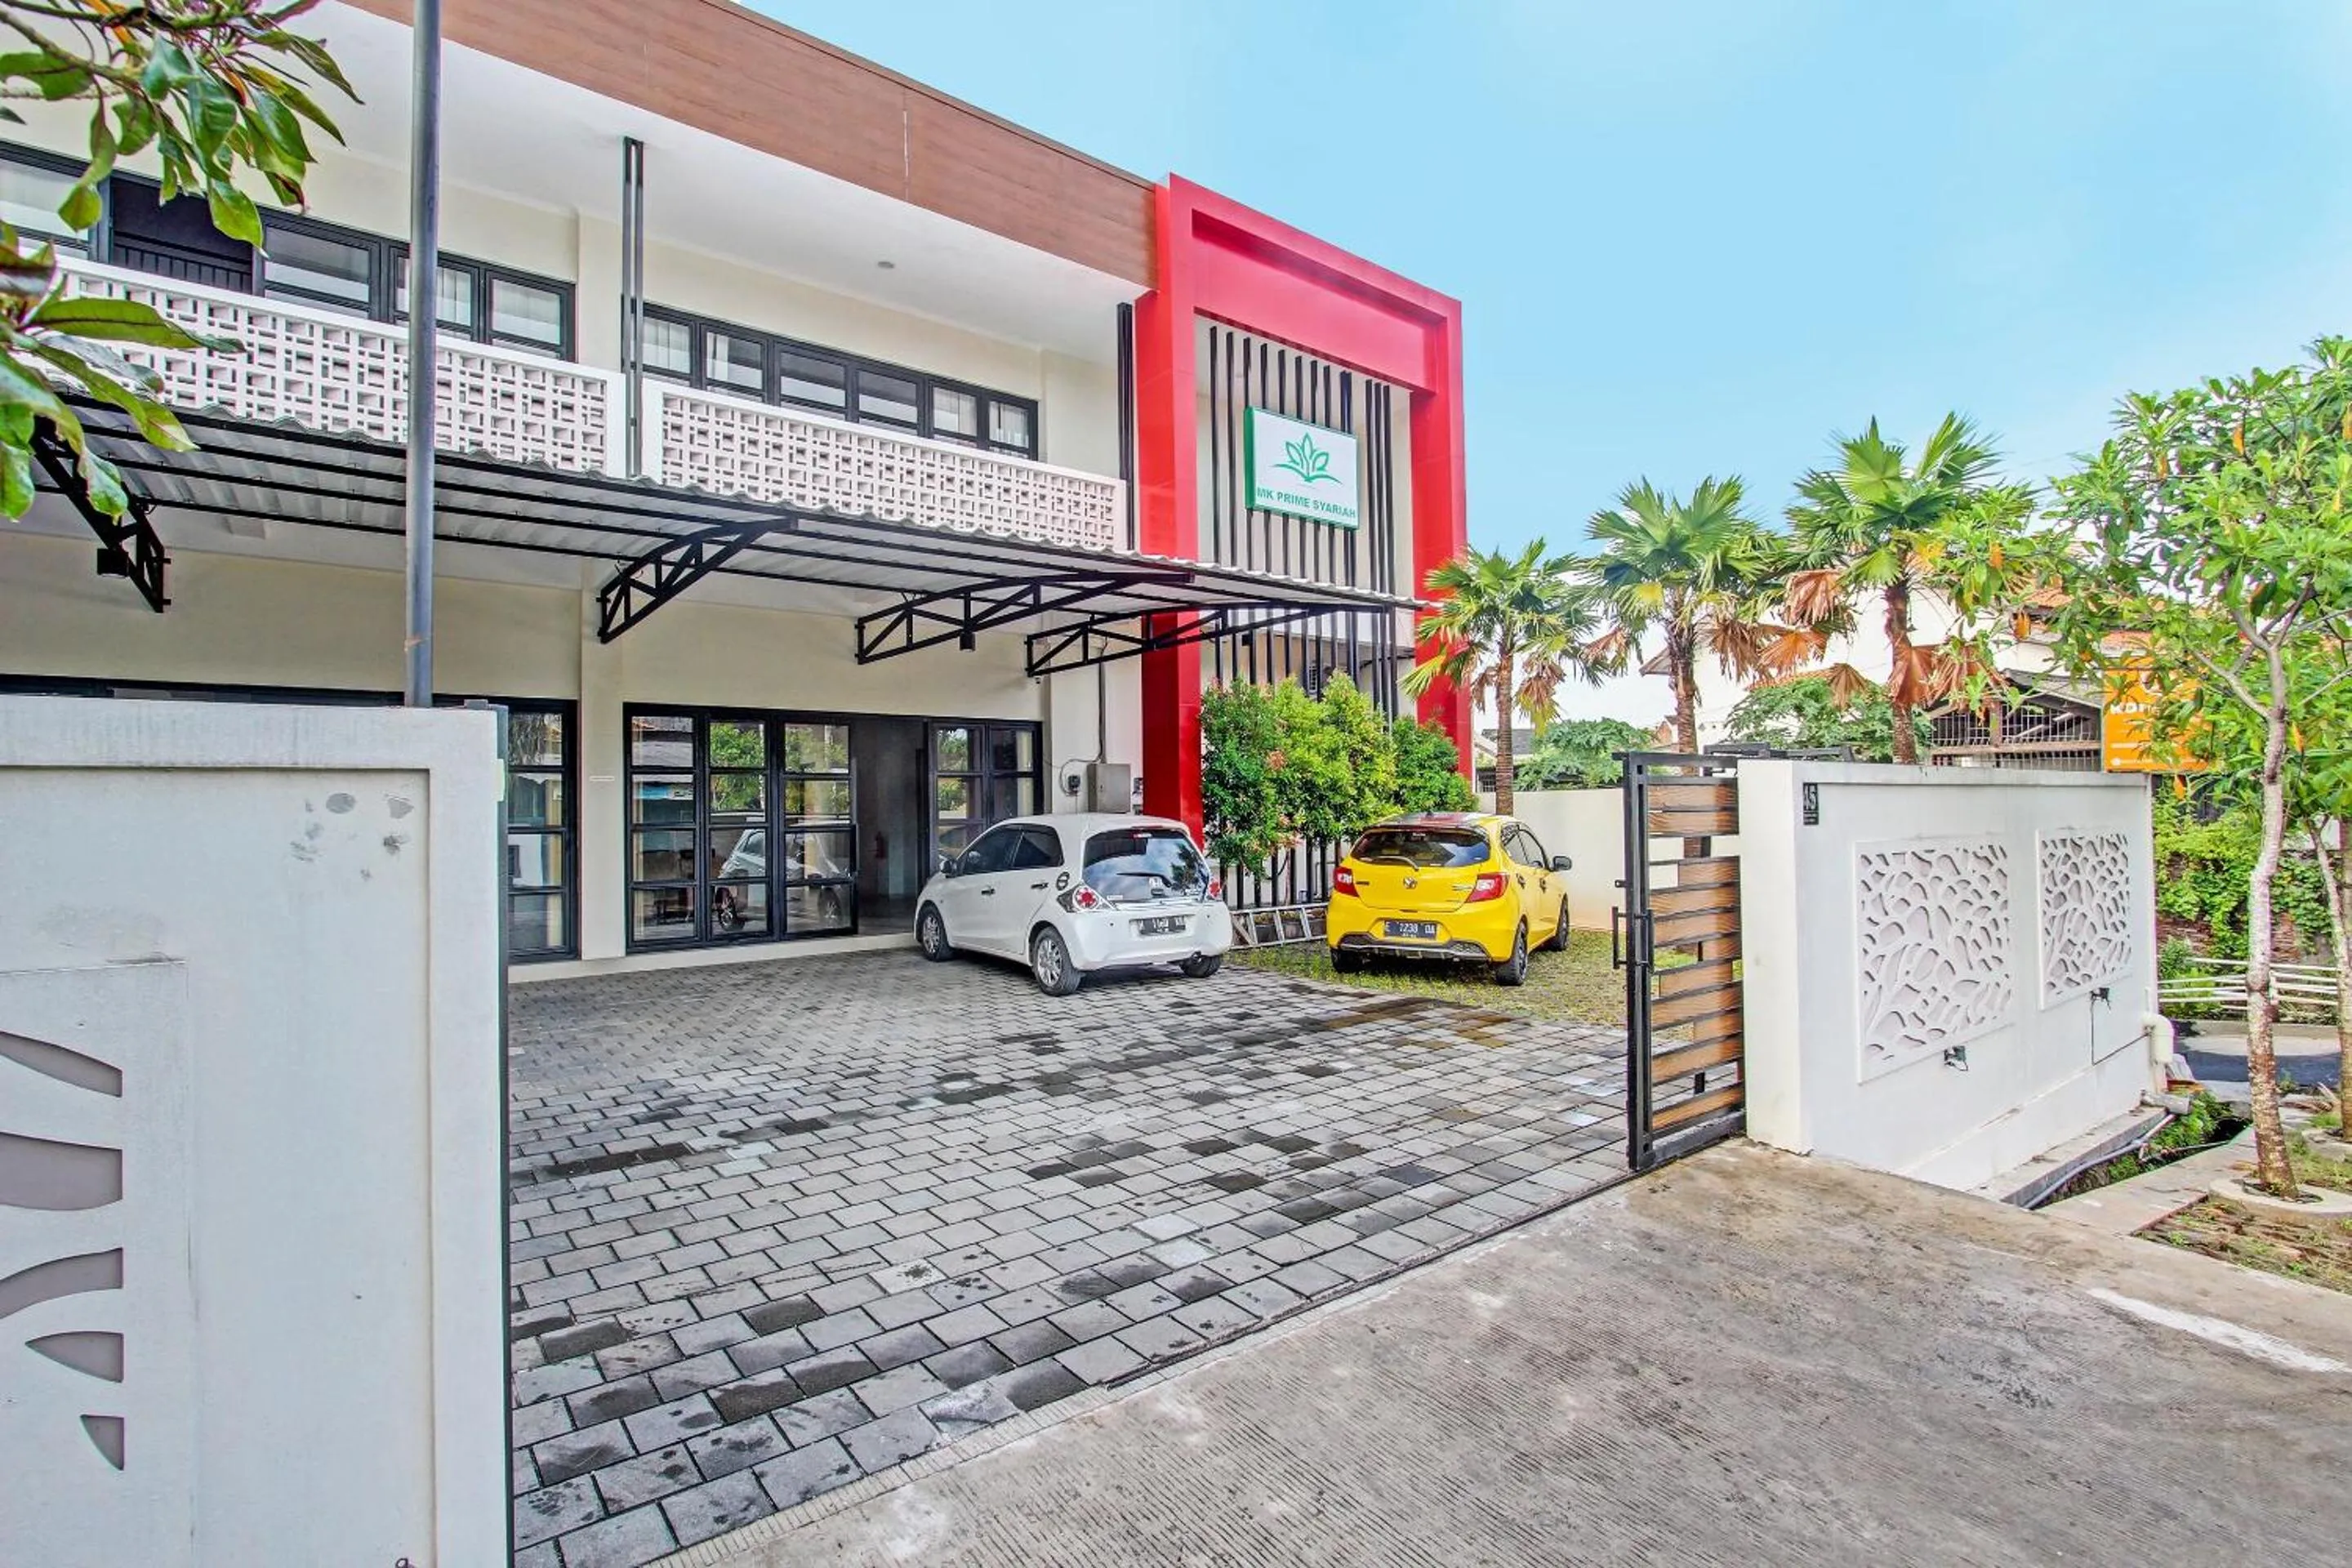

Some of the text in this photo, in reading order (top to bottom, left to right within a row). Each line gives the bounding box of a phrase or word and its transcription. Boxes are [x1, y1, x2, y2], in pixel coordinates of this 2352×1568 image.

[1257, 487, 1356, 518] MK PRIME SYARIAH
